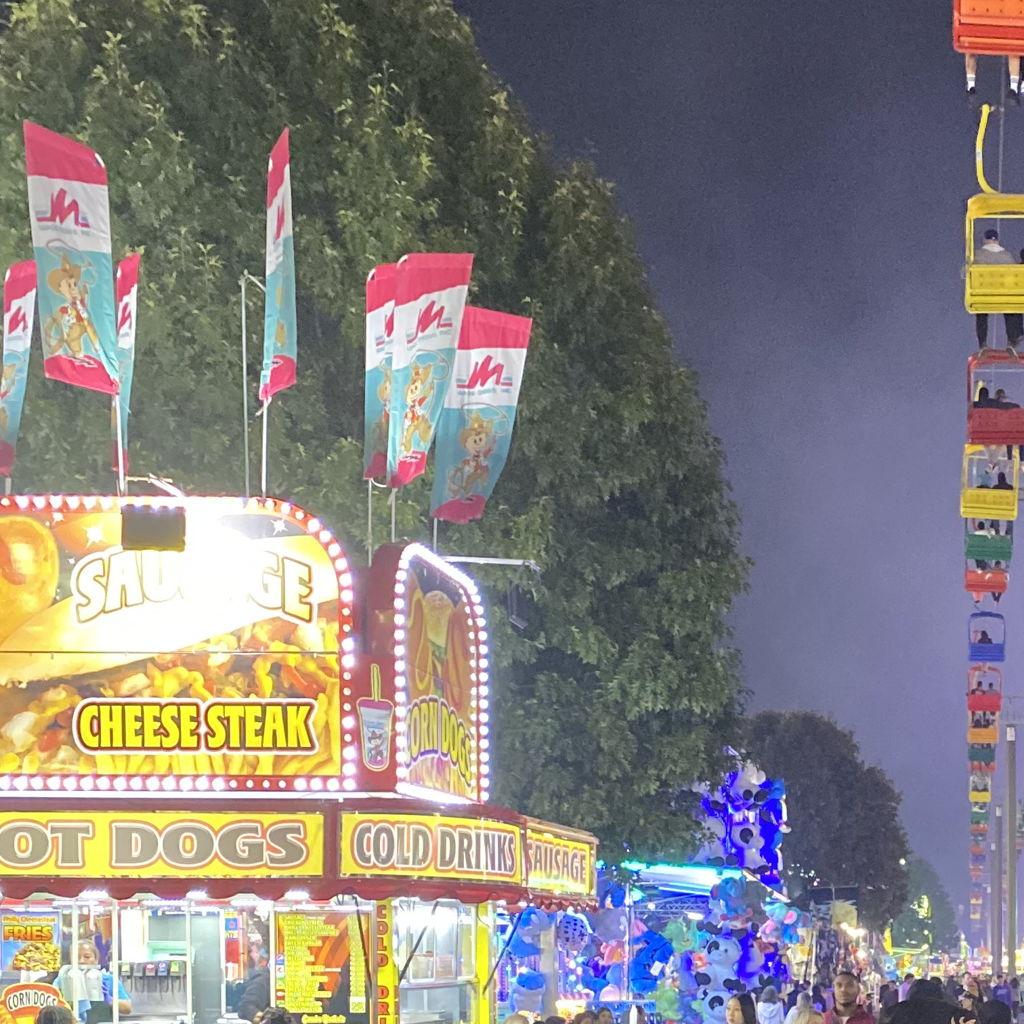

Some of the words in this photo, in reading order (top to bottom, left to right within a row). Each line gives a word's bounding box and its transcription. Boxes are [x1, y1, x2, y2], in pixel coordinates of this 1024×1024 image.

[76, 549, 312, 624] SAUGE
[79, 703, 199, 749] CHEESE
[205, 703, 312, 749] STEAK
[110, 822, 307, 867] DOGS
[354, 822, 433, 868] COLD
[437, 825, 516, 875] DRINKS
[527, 840, 587, 885] SAUSAGE
[3, 924, 54, 941] FRIES
[377, 903, 389, 968] COLD
[8, 990, 31, 1011] CORN
